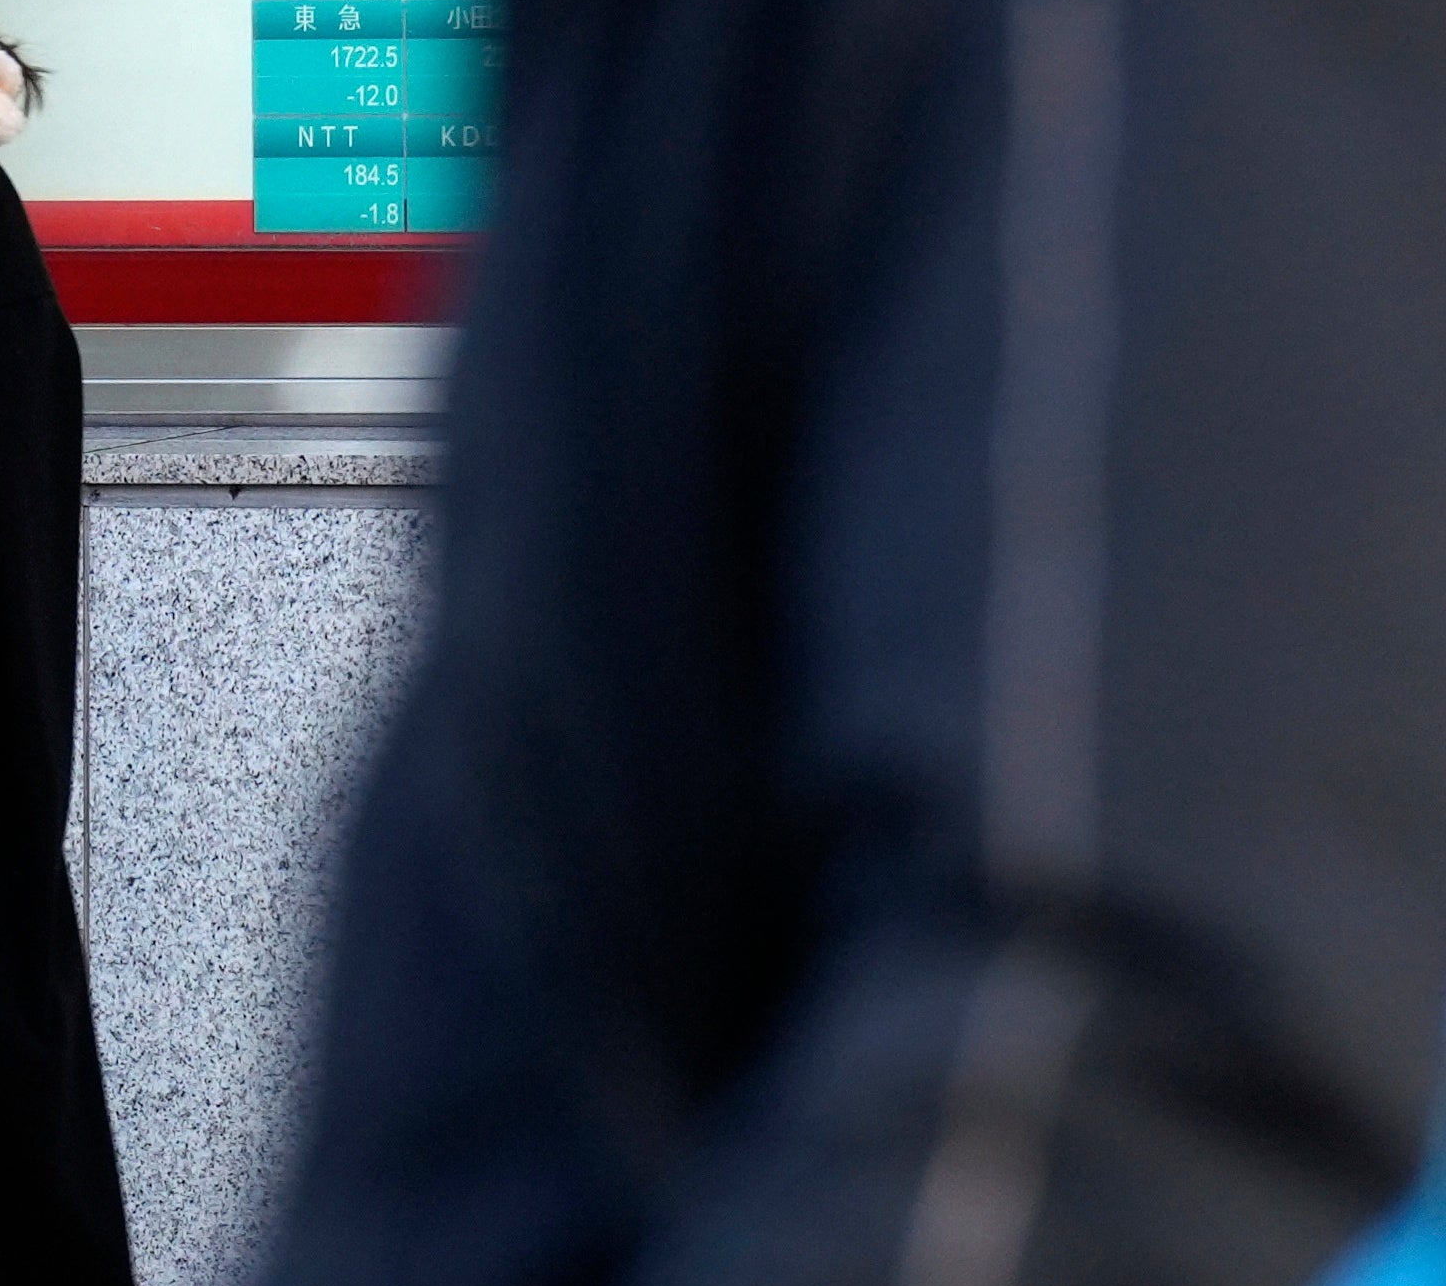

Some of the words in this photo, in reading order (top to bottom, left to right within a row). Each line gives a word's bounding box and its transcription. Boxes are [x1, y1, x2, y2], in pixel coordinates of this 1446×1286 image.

[448, 5, 494, 30] 小田
[330, 46, 398, 68] 1722.5
[346, 84, 398, 107] -12.0
[297, 126, 359, 148] NTT
[343, 164, 399, 186] 184.5
[359, 203, 399, 225] -1.8
